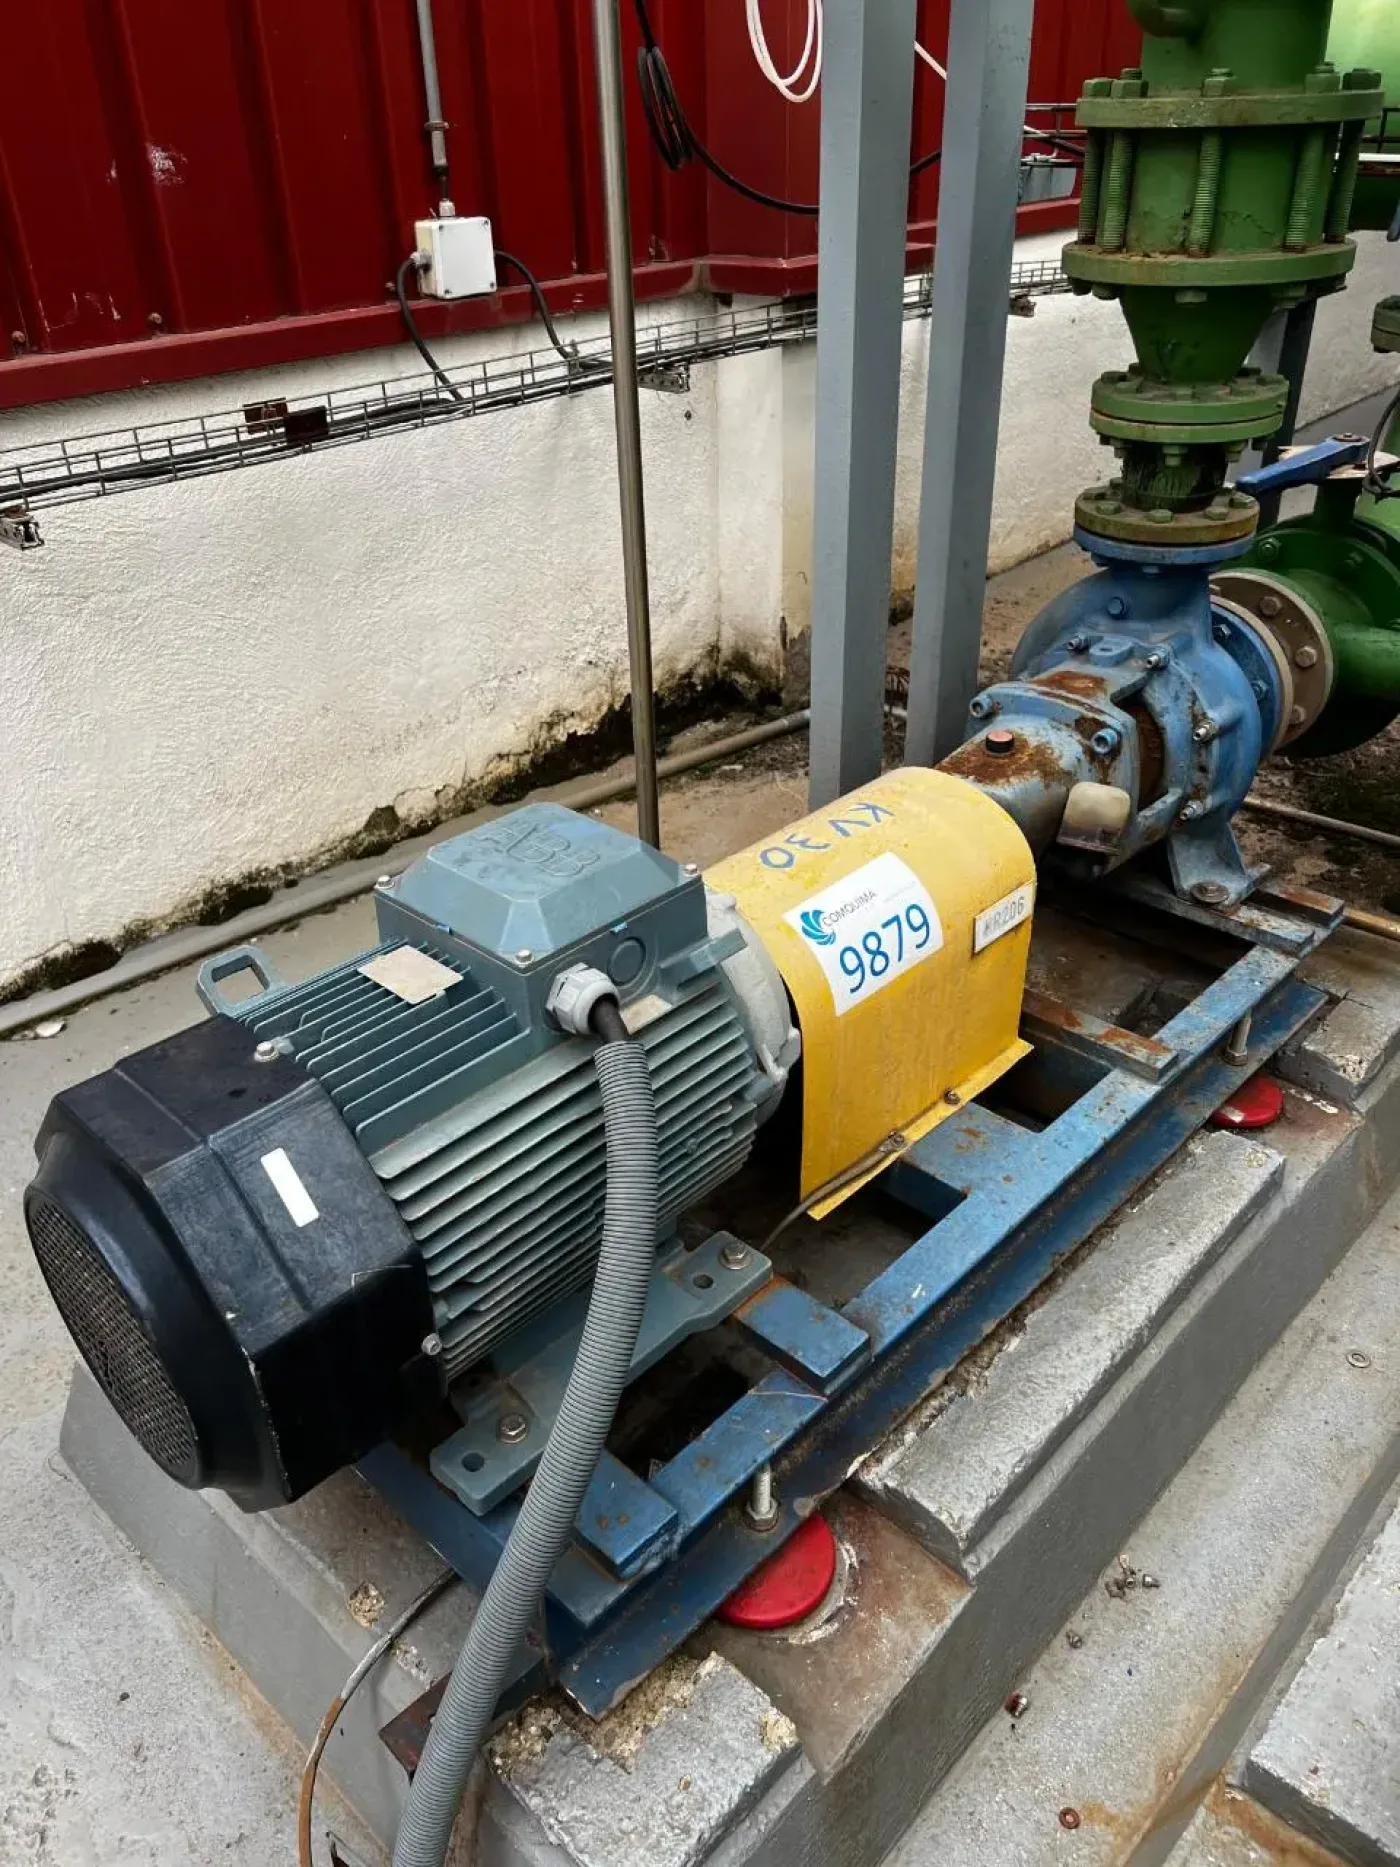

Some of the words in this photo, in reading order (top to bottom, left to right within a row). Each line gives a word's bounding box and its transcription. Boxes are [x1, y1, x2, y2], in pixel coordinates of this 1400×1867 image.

[759, 833, 832, 868] 30
[823, 889, 877, 926] COMQUIMA
[839, 903, 930, 993] 9879
